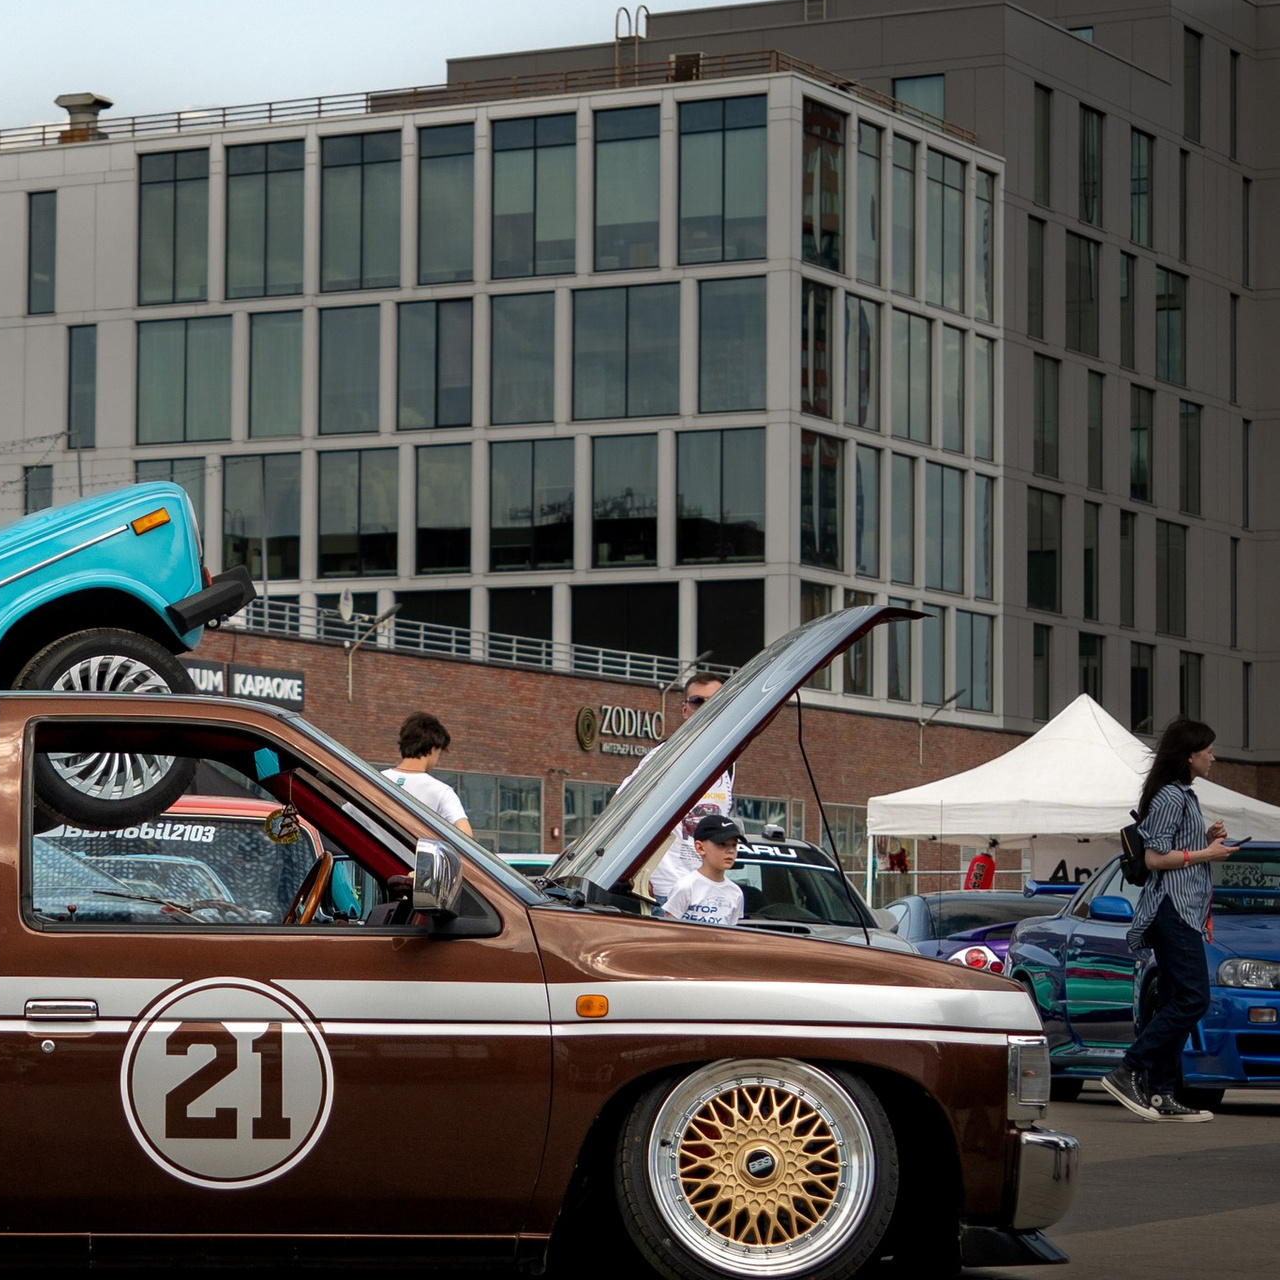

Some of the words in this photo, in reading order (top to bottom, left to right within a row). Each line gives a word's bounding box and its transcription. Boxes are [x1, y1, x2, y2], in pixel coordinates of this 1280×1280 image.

[233, 672, 303, 701] КАРАОКЕ
[601, 705, 665, 740] ZODIAC
[165, 1022, 291, 1140] 21
[748, 1156, 773, 1173] BBS
